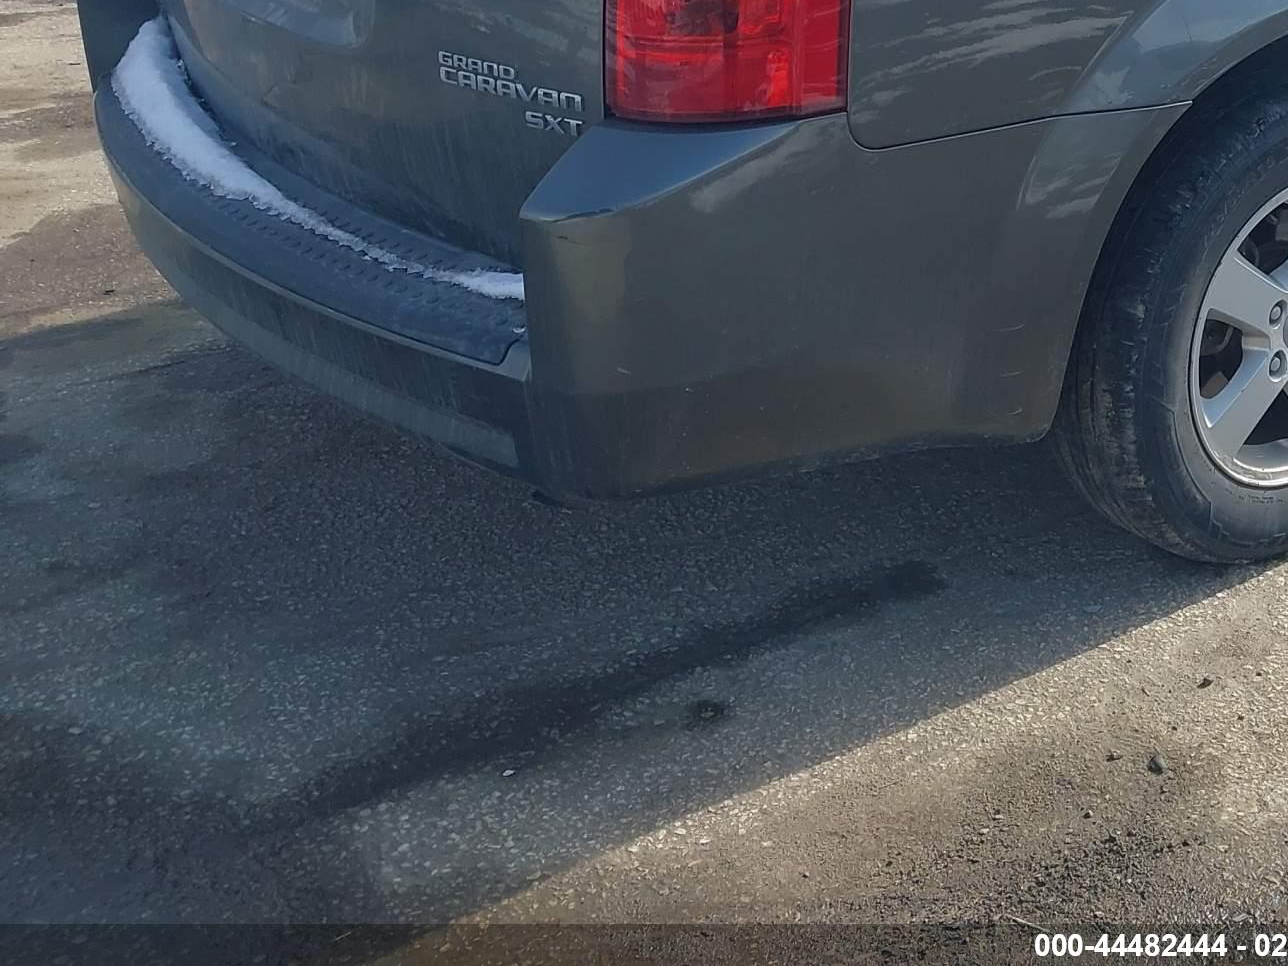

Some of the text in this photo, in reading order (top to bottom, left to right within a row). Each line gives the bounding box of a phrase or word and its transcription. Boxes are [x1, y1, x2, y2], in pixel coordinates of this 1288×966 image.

[438, 50, 515, 80] GRAND
[439, 66, 583, 112] CARAVAN
[525, 110, 583, 136] SXT
